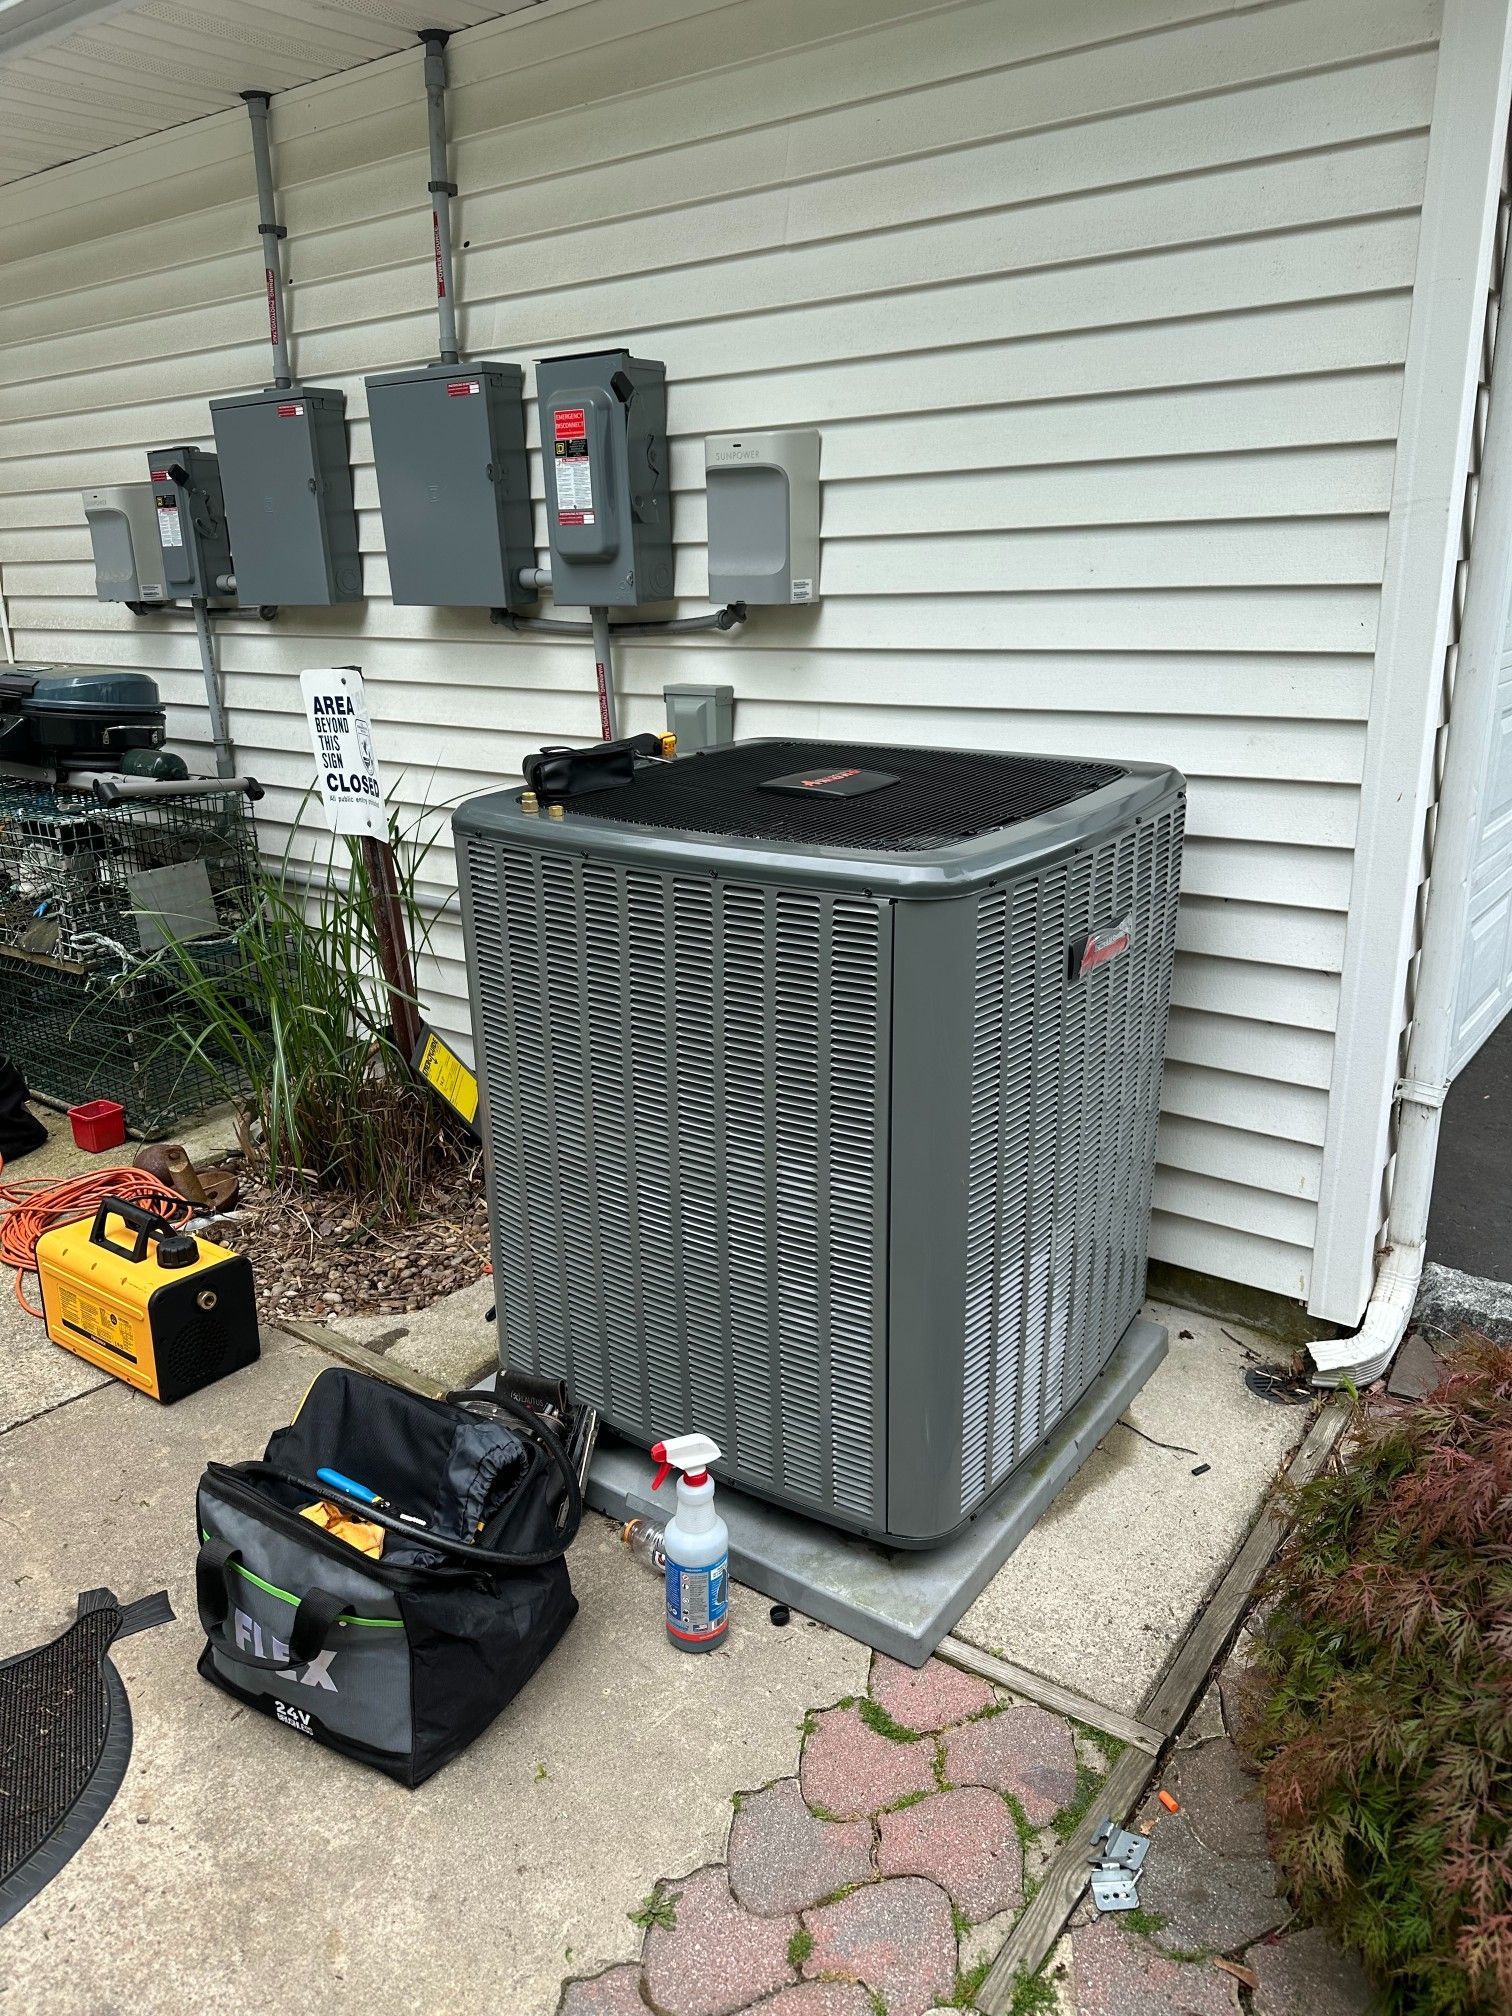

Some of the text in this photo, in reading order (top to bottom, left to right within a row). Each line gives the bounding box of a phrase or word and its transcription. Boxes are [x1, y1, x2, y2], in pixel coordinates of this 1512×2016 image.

[715, 450, 760, 461] SUNPOWER
[313, 695, 355, 716] AREA
[315, 717, 350, 733] BEYOND
[601, 695, 611, 741] PHOTOVOLTAIC
[318, 735, 341, 751] THIS
[321, 752, 344, 769] SIGN
[326, 773, 380, 798] CLOSED
[234, 1607, 339, 1693] FLEX
[274, 1700, 311, 1726] 24V
